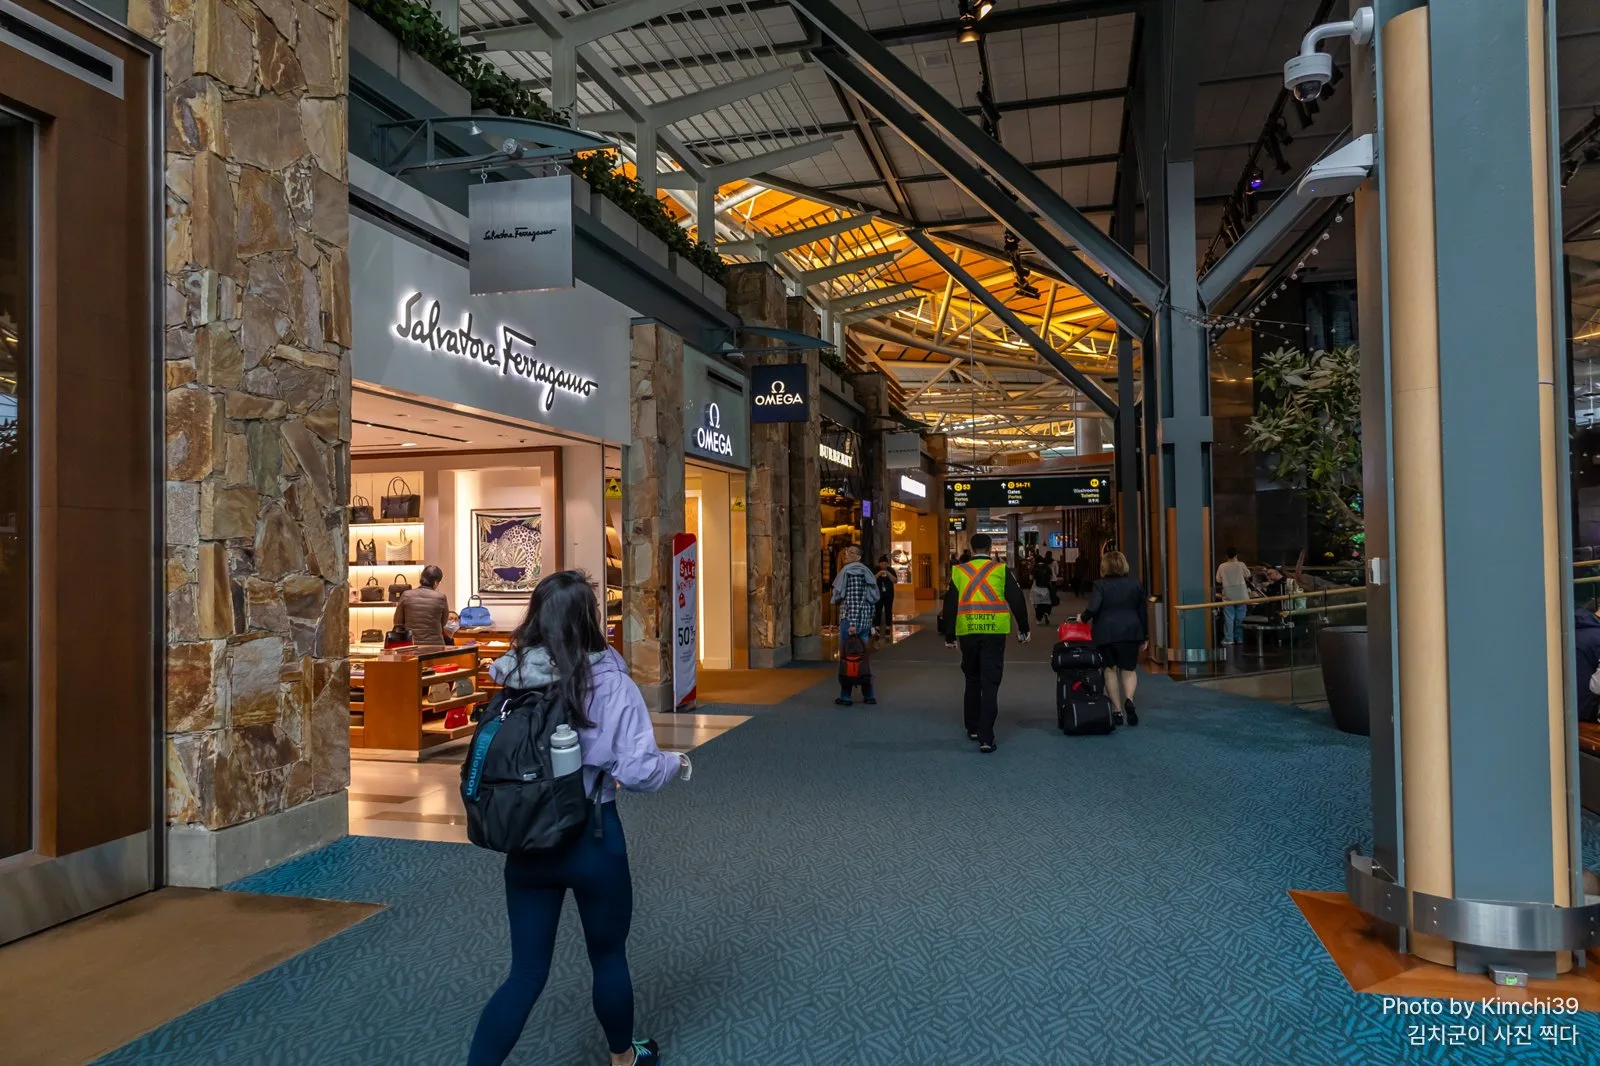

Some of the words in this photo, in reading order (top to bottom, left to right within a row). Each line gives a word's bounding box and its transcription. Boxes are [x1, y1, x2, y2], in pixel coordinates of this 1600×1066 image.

[483, 228, 514, 241] Salvatore
[514, 227, 557, 242] Ferragamo
[395, 290, 502, 367] Salvatore
[502, 325, 599, 411] Ferragamo
[755, 393, 803, 406] OMEGA
[697, 427, 733, 457] OMEGA
[819, 443, 853, 468] BURBERRY
[680, 563, 696, 577] SALE
